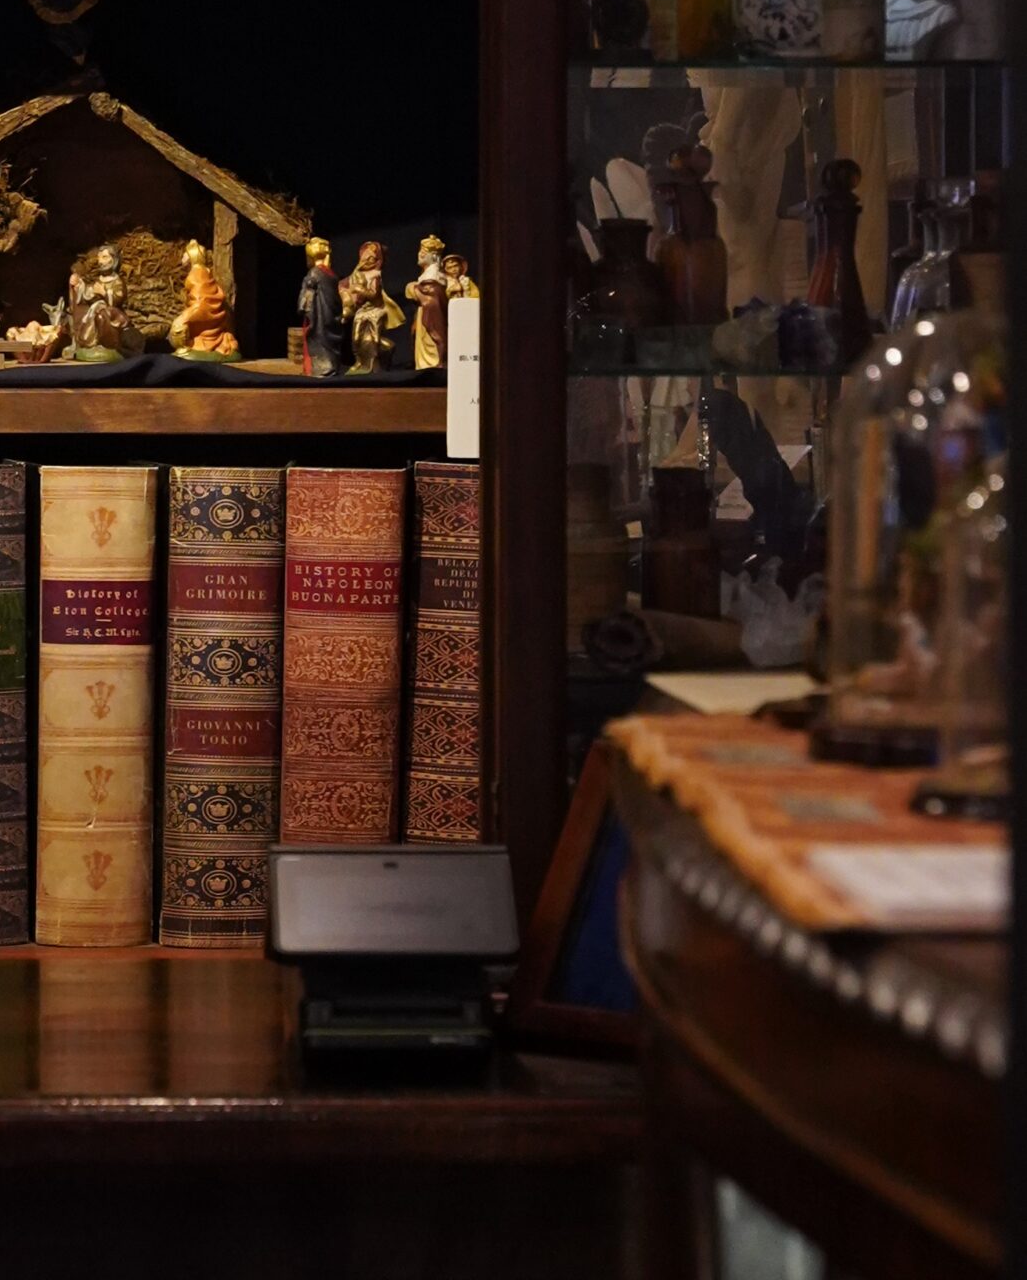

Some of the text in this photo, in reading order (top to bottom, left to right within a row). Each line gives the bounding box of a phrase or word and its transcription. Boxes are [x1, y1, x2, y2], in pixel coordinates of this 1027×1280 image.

[294, 565, 399, 578] HISTORY OF
[204, 574, 249, 585] GRAN
[302, 577, 394, 591] NAPOLEON
[66, 588, 139, 600] History of
[186, 589, 268, 601] GRIMOIRE
[291, 591, 400, 606] BUONAPARTE
[52, 605, 150, 617] Eton College
[65, 627, 80, 637] Sir
[186, 720, 262, 732] GIOVANNI
[199, 734, 249, 746] TOKIO
